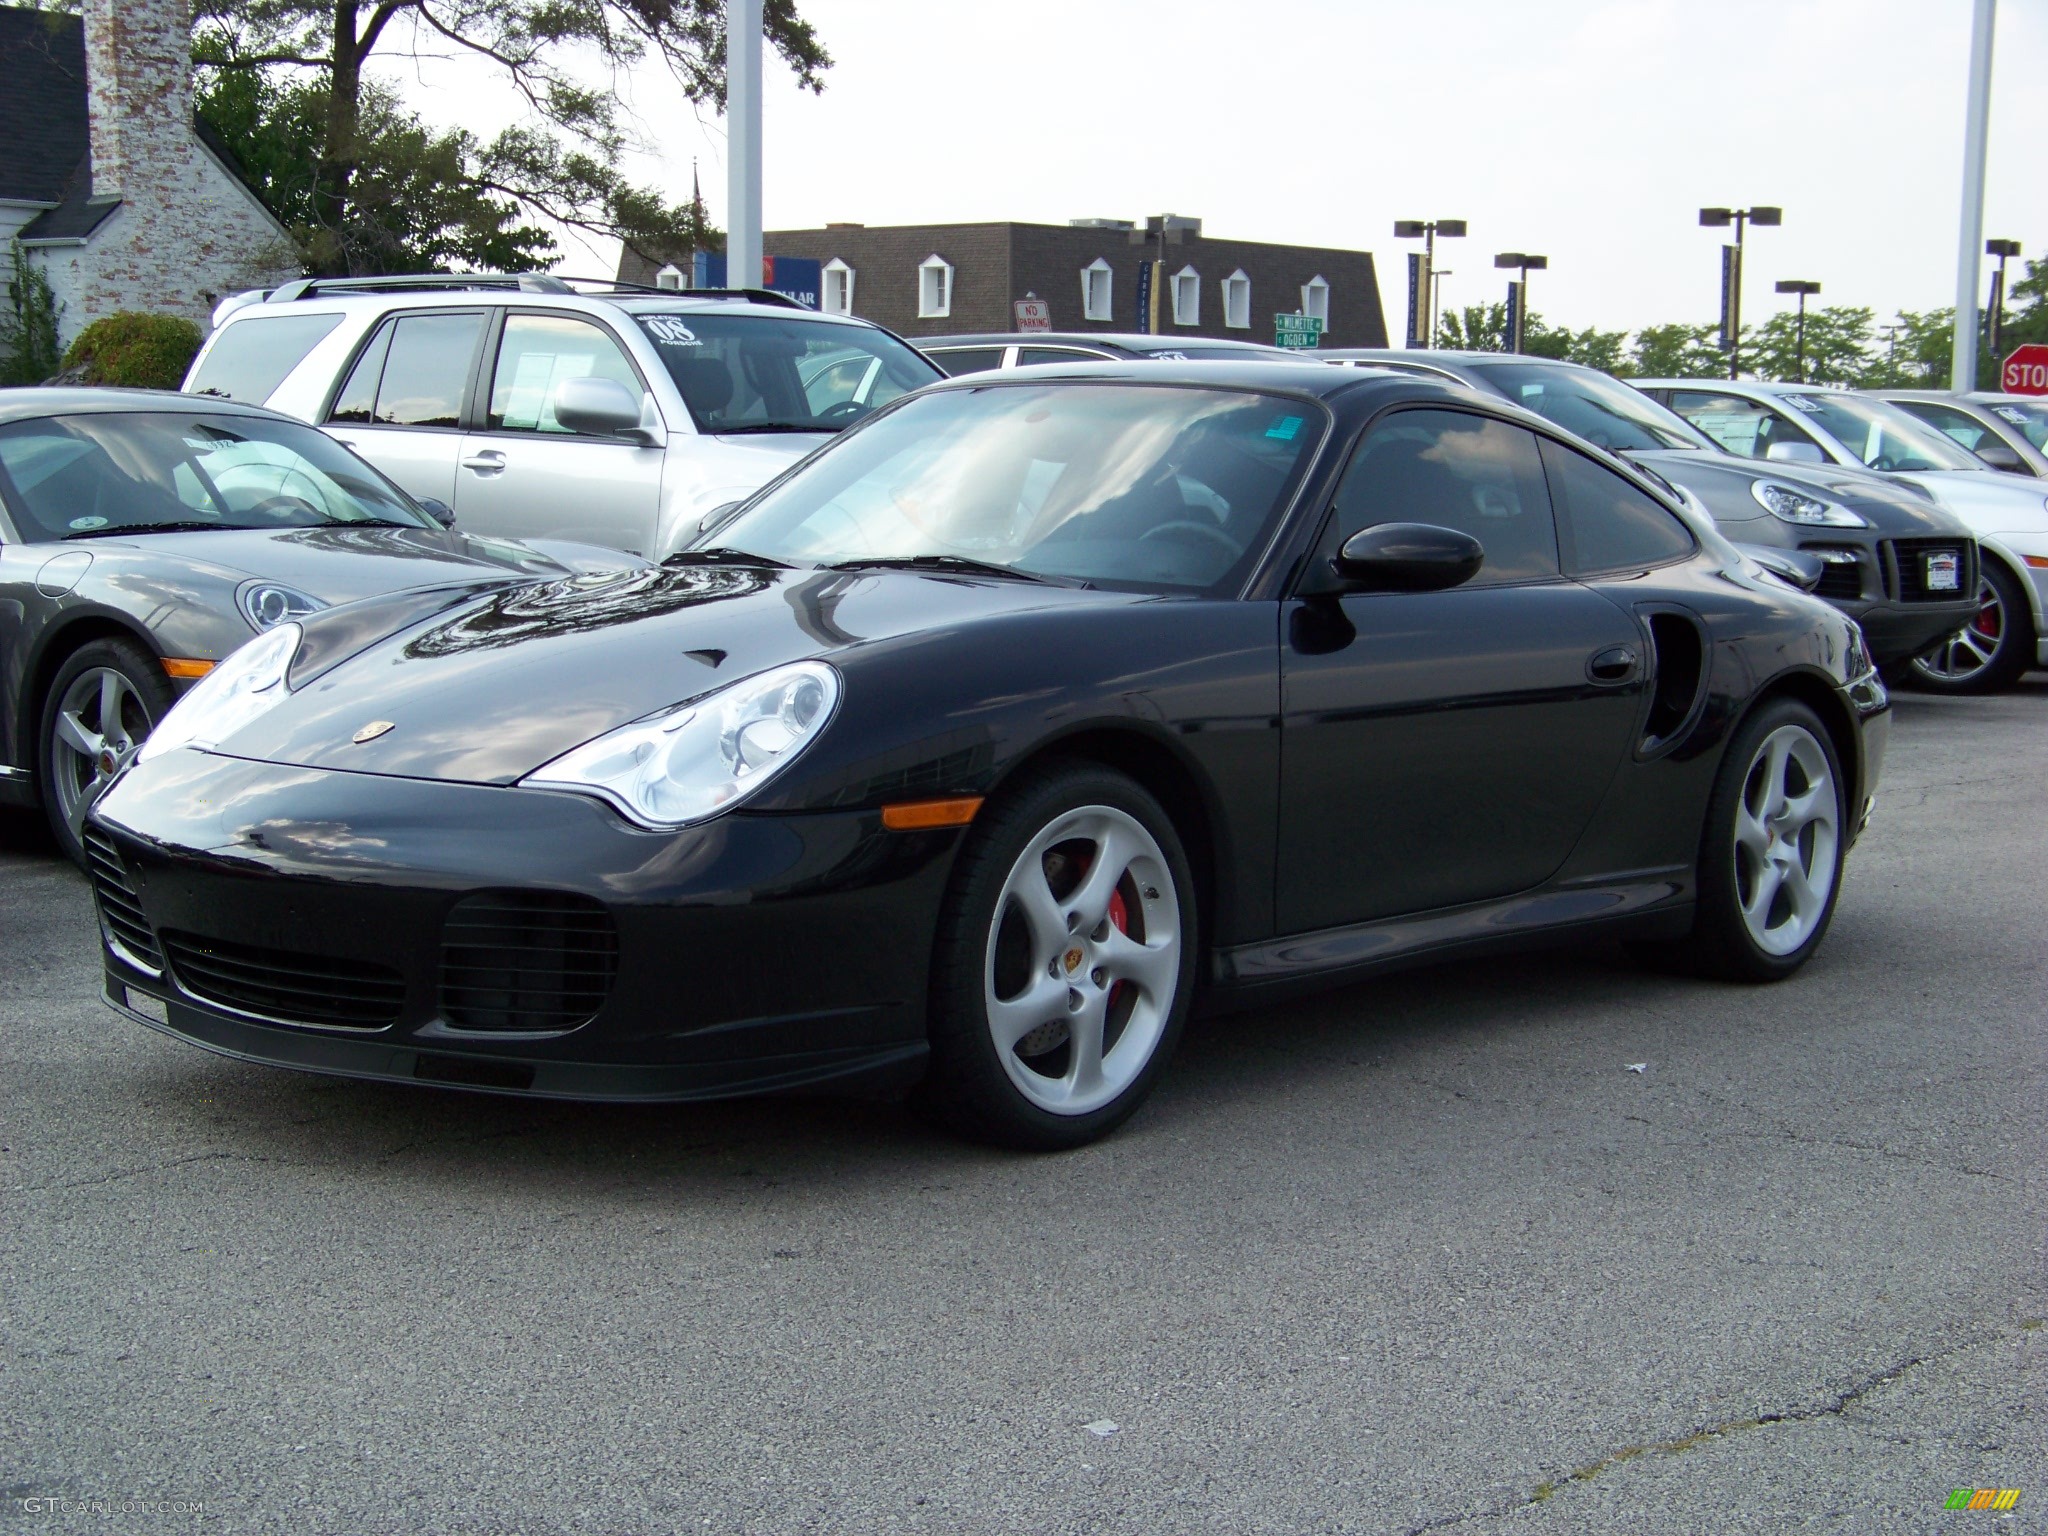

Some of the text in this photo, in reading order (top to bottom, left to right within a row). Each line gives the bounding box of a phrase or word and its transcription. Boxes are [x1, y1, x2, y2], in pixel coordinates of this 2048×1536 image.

[1025, 305, 1038, 316] NO
[1019, 317, 1048, 328] PARKING
[1284, 316, 1314, 331] WILMETTE
[647, 320, 695, 341] 08
[1283, 333, 1308, 346] OGDEN
[2006, 364, 2048, 388] STO
